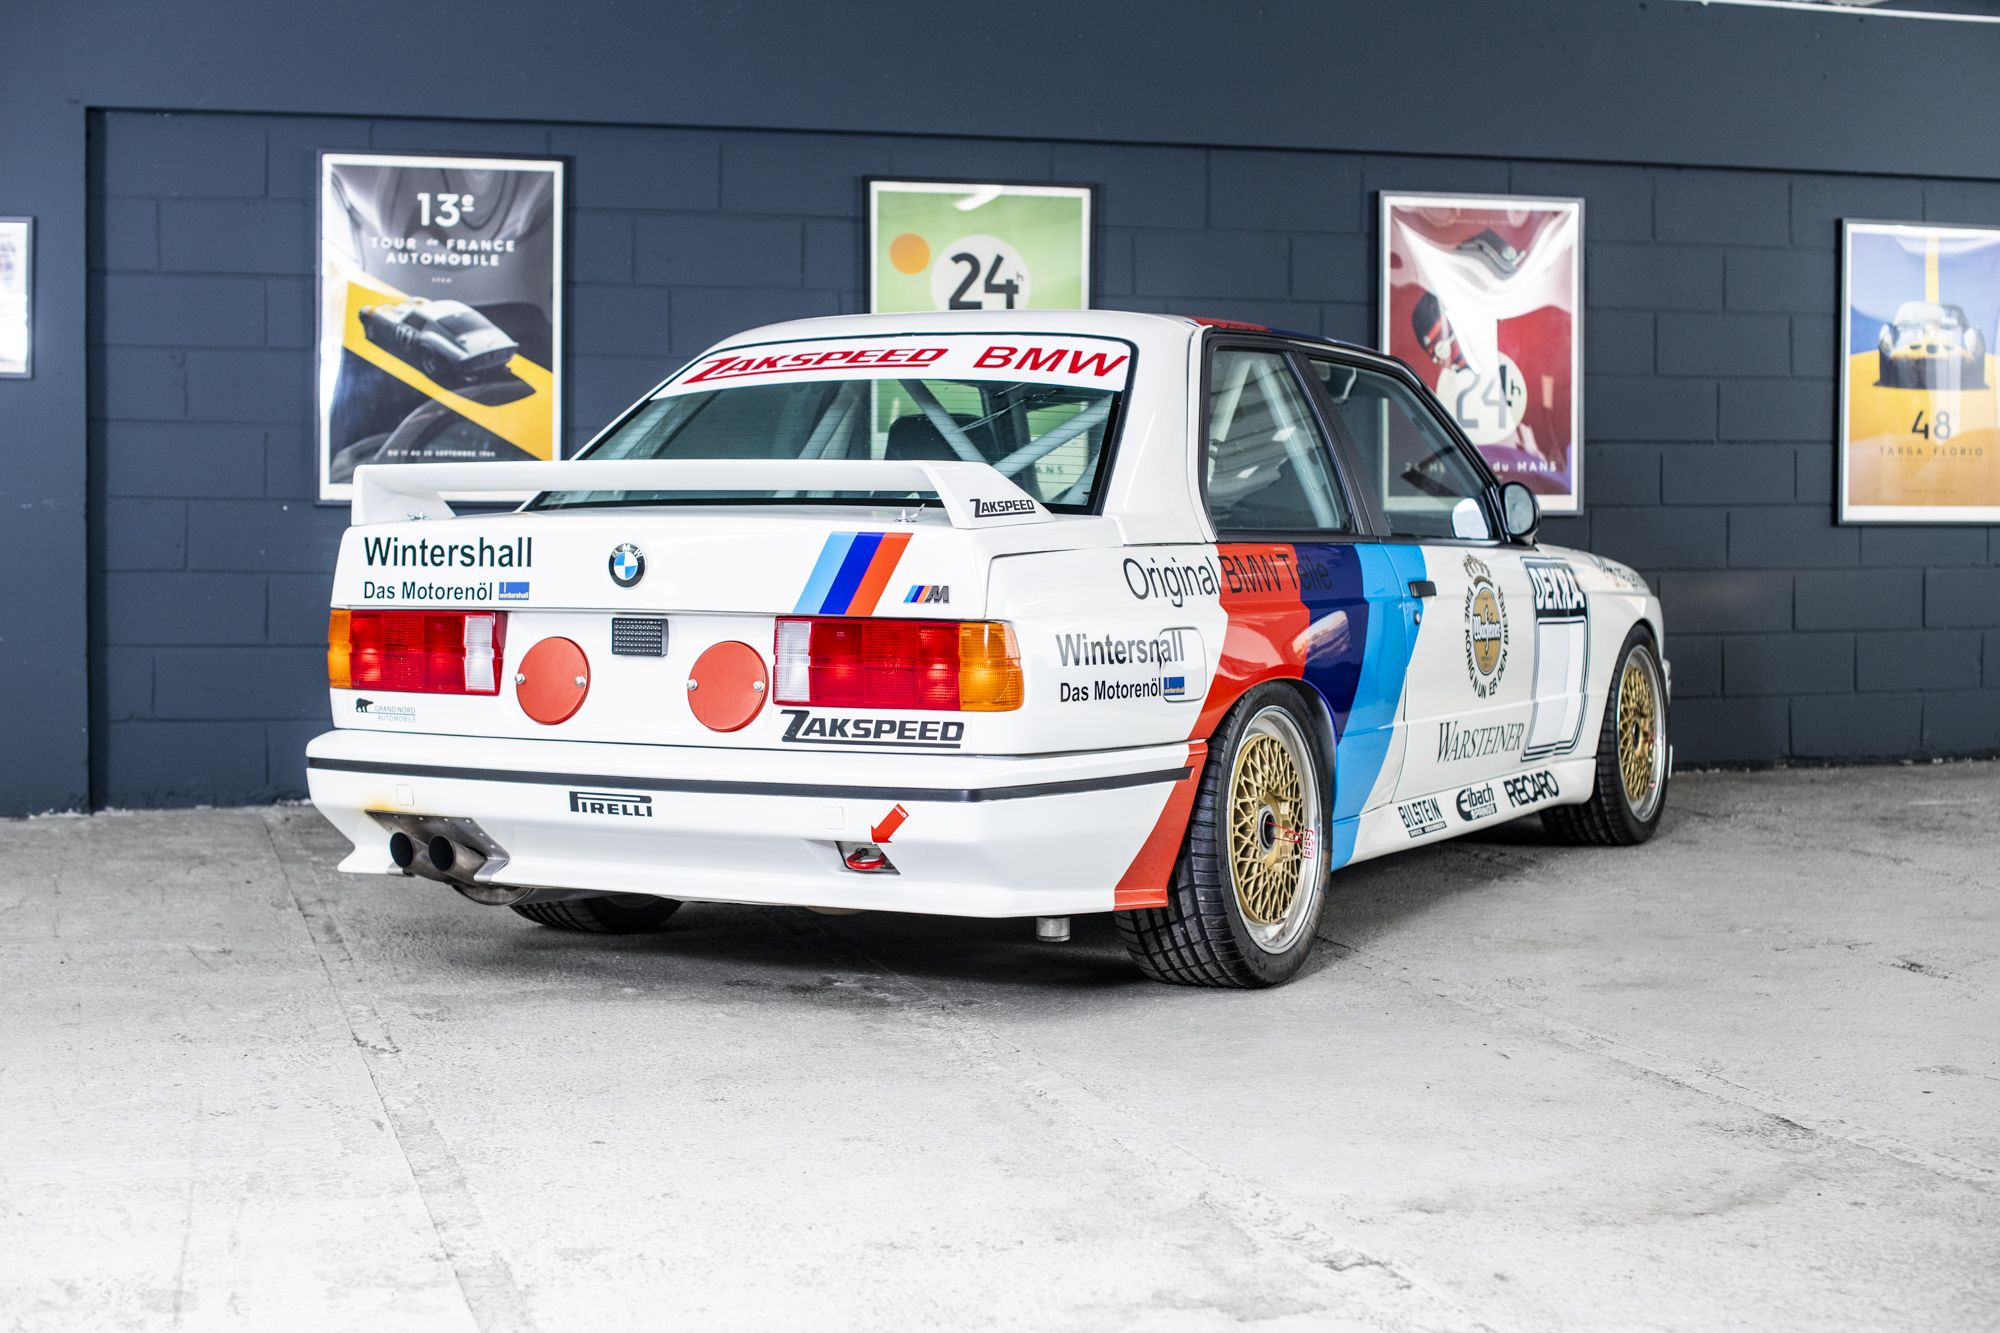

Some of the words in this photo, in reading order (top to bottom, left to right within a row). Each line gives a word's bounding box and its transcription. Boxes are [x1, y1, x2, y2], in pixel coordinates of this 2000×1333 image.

[370, 236, 416, 250] TOUR
[446, 238, 515, 252] FRANCE
[386, 252, 500, 266] AUTOMOBILE
[682, 348, 949, 384] ZAKSPEED
[972, 346, 1129, 377] BMW
[1911, 410, 1951, 440] 48
[1880, 446, 1923, 456] TARGA
[1933, 447, 1983, 457] FLORIO
[1517, 462, 1557, 472] MANS
[970, 498, 1036, 518] ZAKSPEED
[364, 537, 532, 567] Wintershall
[364, 581, 395, 599] Das
[402, 581, 493, 600] Motorenöl
[1123, 556, 1222, 607] Original
[1218, 555, 1282, 593] BMW
[1275, 553, 1333, 592] Teile
[1527, 567, 1586, 609] DEKRA
[1060, 682, 1089, 702] Das
[1094, 677, 1162, 701] Motorenöl
[374, 704, 397, 713] GRAND
[397, 706, 416, 714] NORD
[780, 710, 965, 748] ZAKSPEED
[1436, 721, 1525, 764] WARSTEINER
[569, 791, 653, 817] PIRELLI
[1456, 782, 1495, 821] Eibach
[1503, 770, 1559, 808] RECARO
[1398, 797, 1443, 828] BILSTEIN
